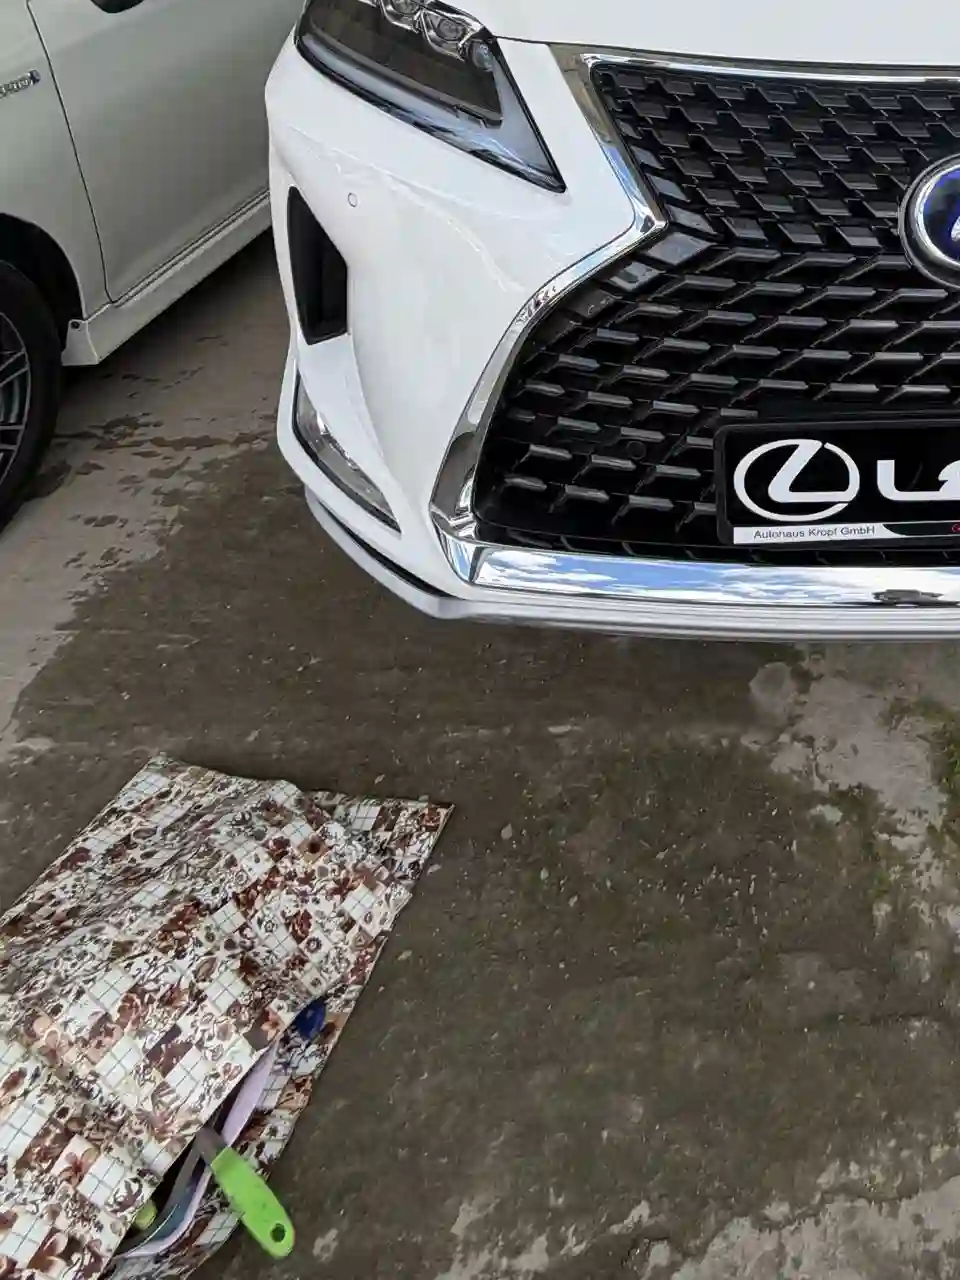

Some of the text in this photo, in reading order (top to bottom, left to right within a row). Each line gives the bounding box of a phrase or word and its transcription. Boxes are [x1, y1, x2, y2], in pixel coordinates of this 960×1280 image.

[753, 525, 876, 540] Autohaus Kropf GmbH
